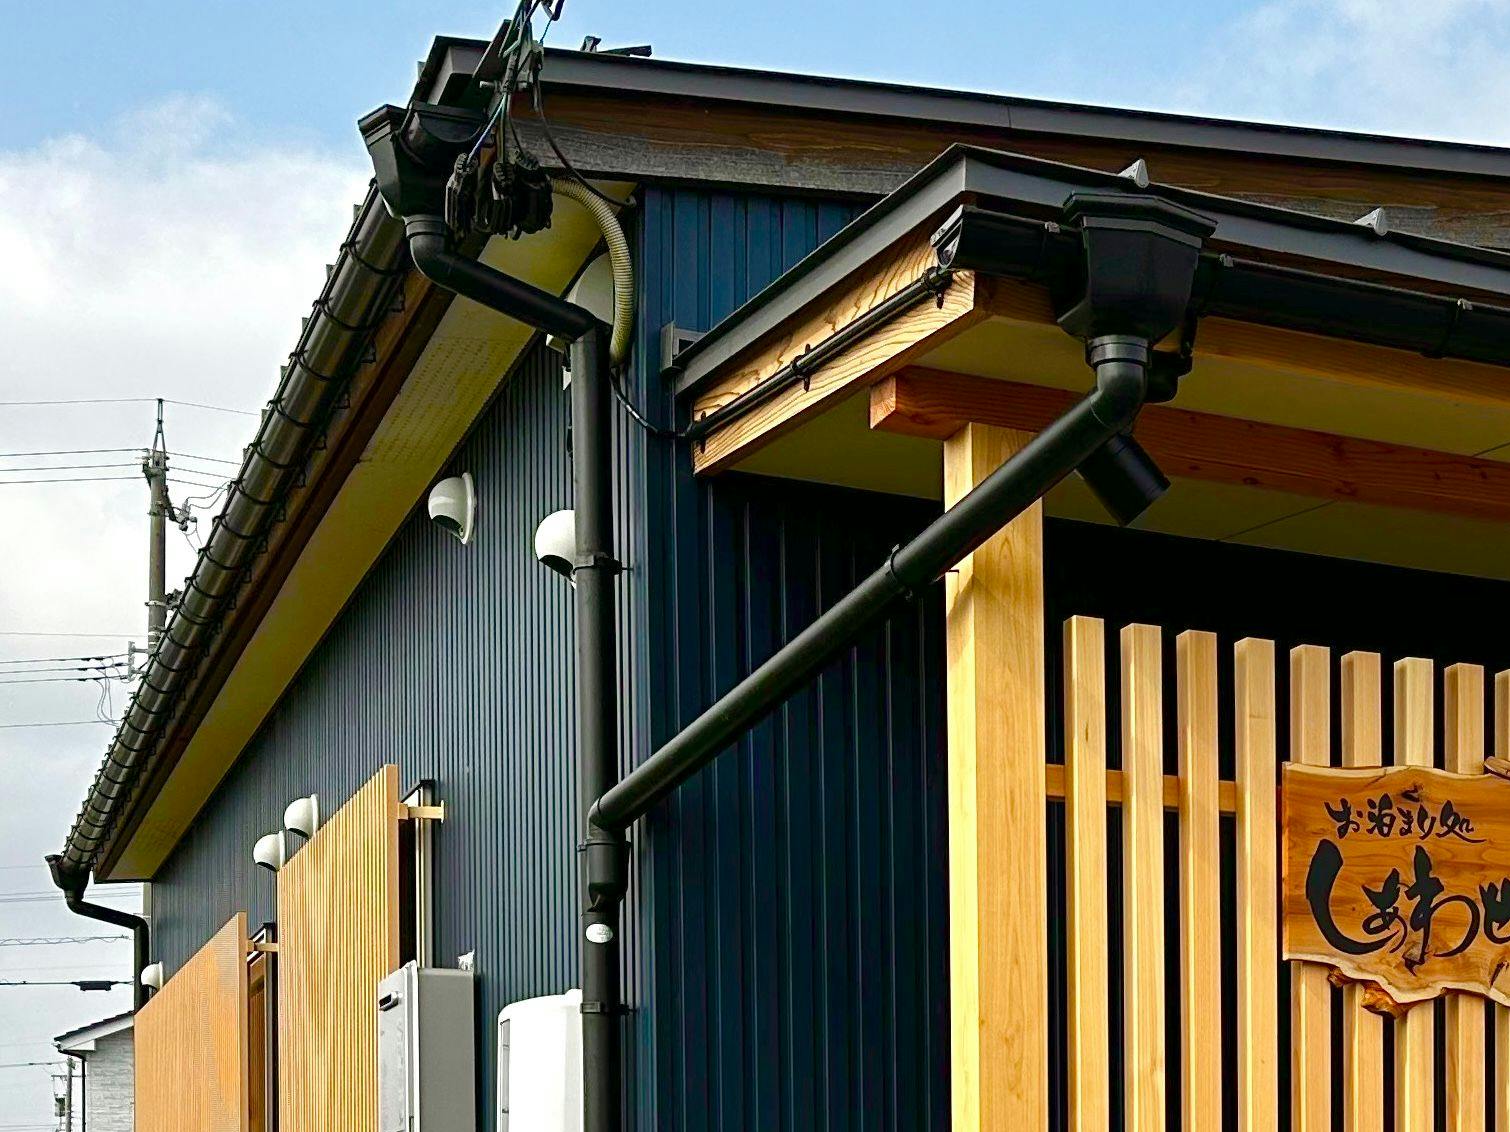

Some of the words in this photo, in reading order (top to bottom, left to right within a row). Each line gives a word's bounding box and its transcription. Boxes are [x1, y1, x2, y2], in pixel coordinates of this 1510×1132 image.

[1324, 792, 1487, 843] お泊まり処
